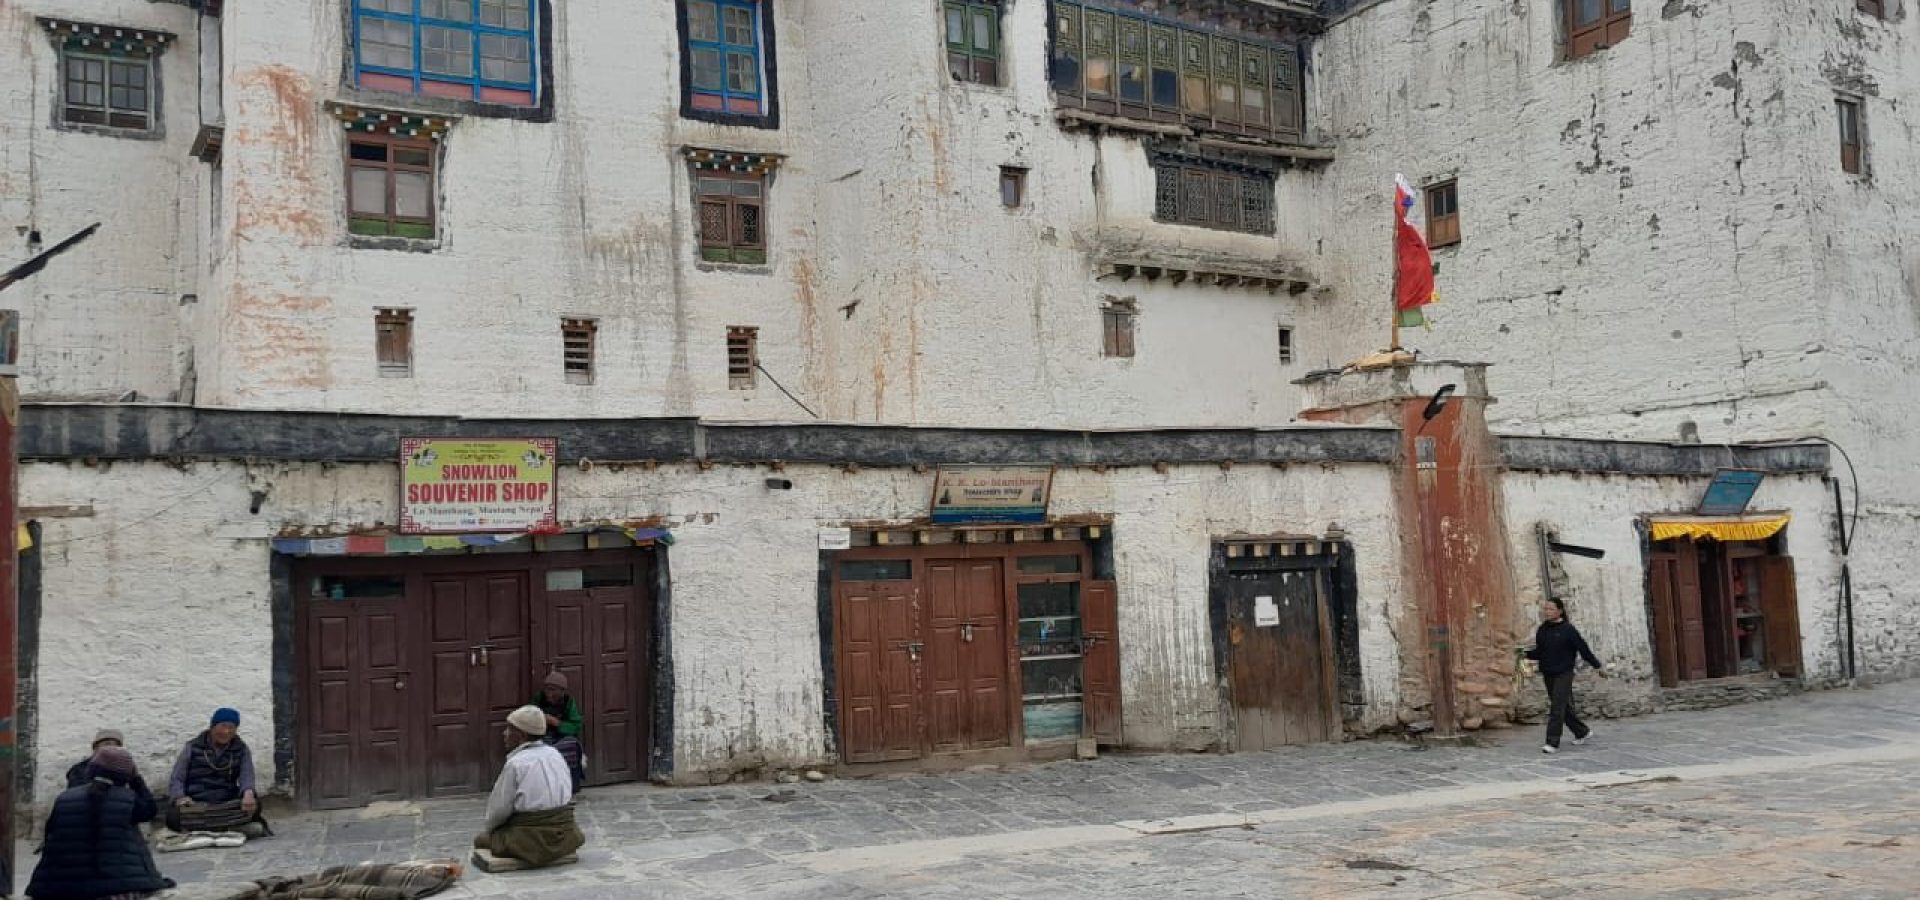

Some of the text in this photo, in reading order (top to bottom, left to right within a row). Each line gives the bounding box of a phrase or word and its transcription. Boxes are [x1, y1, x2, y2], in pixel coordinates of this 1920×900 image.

[442, 464, 517, 480] SNOWLION
[408, 482, 549, 504] SOUVENIR SHOP
[519, 506, 544, 514] Nepal
